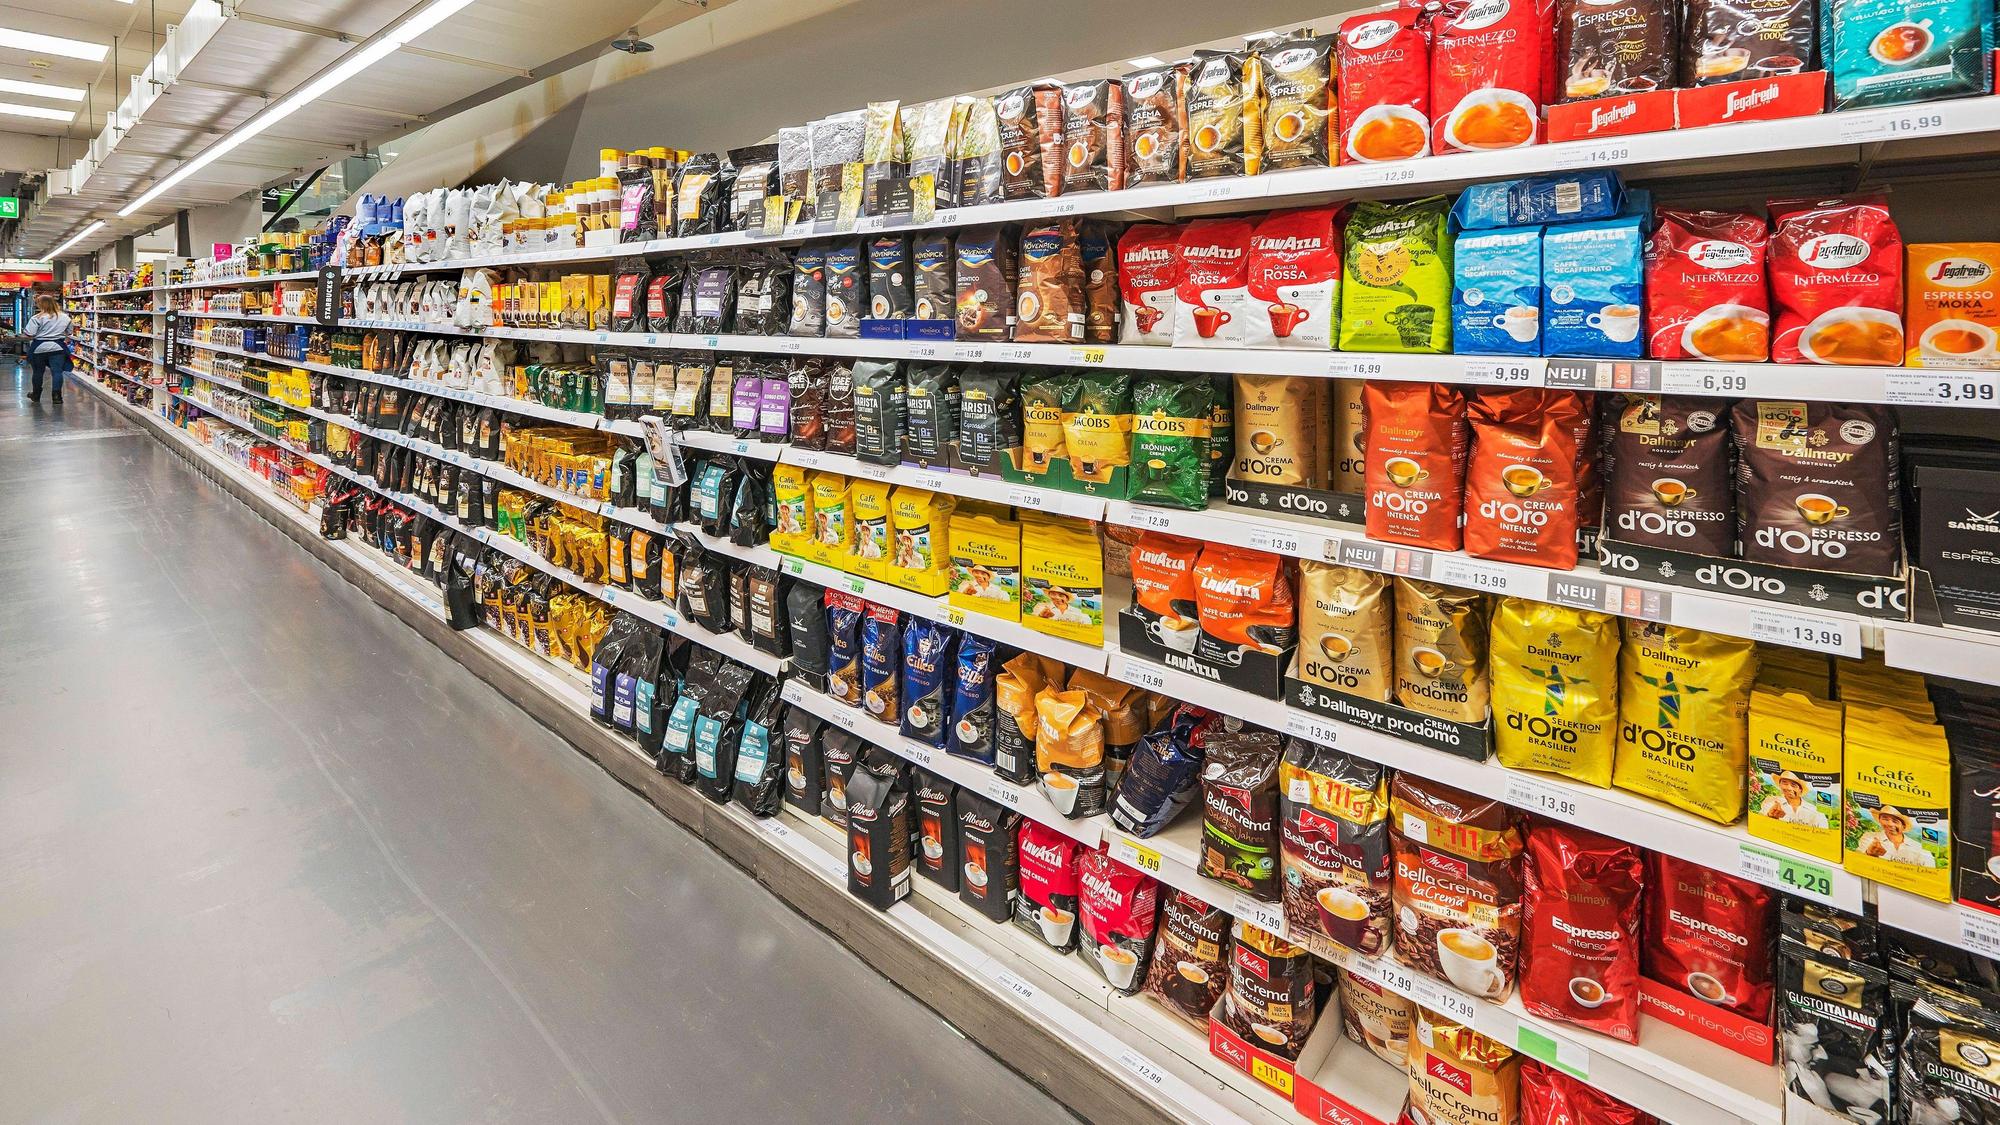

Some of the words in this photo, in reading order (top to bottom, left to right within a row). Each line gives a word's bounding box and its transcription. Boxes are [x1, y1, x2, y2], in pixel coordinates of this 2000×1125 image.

[1578, 8, 1636, 28] ESPRESSO
[1612, 15, 1646, 27] CASA
[1444, 28, 1517, 49] INTERMEZZO
[1342, 49, 1404, 67] INTERMEZZO
[1722, 84, 1779, 118] Segafredo
[1132, 109, 1161, 121] CREMA
[1588, 101, 1636, 133] Segafredo
[1067, 120, 1090, 130] CREMA
[1889, 115, 1942, 132] 16,99
[1590, 148, 1628, 161] 14,99
[1384, 170, 1414, 181] 12,99
[1208, 187, 1231, 197] 16,99
[1363, 219, 1416, 236] LAVAZZA
[1259, 236, 1321, 251] LAVAZZA
[1805, 239, 1865, 262] Segafredo
[1124, 248, 1169, 263] LAVAZZA
[1184, 246, 1242, 258] LAVAZZA
[1465, 264, 1486, 272] CAFFÈ
[1554, 260, 1577, 268] CAFFÈ
[1554, 265, 1612, 274] DECAFFEINATO
[1190, 274, 1229, 285] ROSSA
[1264, 268, 1307, 280] ROSSA
[1465, 268, 1517, 277] DECAFFEINATO
[1681, 271, 1759, 284] INTERMEZZO
[1794, 272, 1879, 287] INTERMEZZO
[325, 280, 333, 320] STARBUCKS
[1924, 291, 1993, 300] ESPRESSO
[1938, 299, 1983, 309] MOKA
[1014, 350, 1031, 359] 13,99
[1084, 353, 1104, 363] 9,99
[1353, 364, 1381, 374] 16,99
[1495, 368, 1529, 381] 9,99
[1547, 367, 1587, 381] NEU!
[832, 376, 851, 385] IDEE
[1704, 375, 1747, 391] 6,99
[1938, 383, 1994, 400] 3,99
[1246, 403, 1280, 413] Dallmayr
[1073, 416, 1110, 428] JACOBS
[1137, 419, 1185, 432] JACOBS
[1380, 424, 1424, 437] Dallmayr
[1141, 443, 1176, 452] KRÖNUNG
[1639, 434, 1696, 448] Dallmayr
[1265, 457, 1294, 465] CREMA
[1782, 448, 1853, 462] Dallmayr
[1240, 458, 1282, 476] d'Oro
[927, 480, 942, 488] 13,99
[1811, 476, 1854, 486] aromatisch
[859, 494, 875, 503] Café
[1023, 496, 1041, 506] 12,99
[1279, 493, 1328, 513] d'Oro
[1373, 491, 1428, 514] d'Oro
[1405, 490, 1442, 500] CREMA
[900, 502, 915, 511] Café
[1480, 500, 1548, 526] d'Oro
[1524, 500, 1563, 511] CREMA
[895, 509, 921, 519] Intención
[1148, 516, 1170, 528] 12,99
[1387, 512, 1420, 522] INTENSA
[1666, 509, 1725, 521] ESPRESSO
[1500, 523, 1539, 534] INTENSA
[1618, 509, 1696, 538] d'Oro
[1948, 521, 2000, 533] SANSIB
[1755, 526, 1847, 559] d'Oro
[1811, 528, 1881, 542] ESPRESSO
[957, 545, 1008, 561] Intención
[968, 540, 996, 552] Café
[1271, 539, 1297, 551] 13,99
[1139, 550, 1186, 571] LAVAZZA
[1345, 547, 1376, 562] NEU!
[1032, 565, 1089, 582] Intención
[1044, 560, 1076, 572] Café
[1473, 572, 1507, 589] 13,99
[1695, 564, 1786, 595] d'Oro
[1201, 576, 1260, 600] LAVAZZA
[1556, 582, 1597, 601] NEU!
[1316, 600, 1357, 617] Dallmayr
[949, 612, 964, 625] 9,99
[1407, 612, 1449, 629] Dallmayr
[1794, 626, 1842, 646] 13,99
[1527, 644, 1583, 664] Dallmayr
[1642, 646, 1701, 669] Dallmayr
[1165, 653, 1221, 681] LAVAZZA
[1306, 662, 1358, 688] d'Oro
[1338, 665, 1371, 676] CREMA
[1142, 673, 1163, 688] 13,99
[1432, 680, 1467, 691] CREMA
[1400, 677, 1468, 703] prodomo
[1320, 694, 1384, 725] Dallmayr
[1387, 716, 1460, 747] prodomo
[1424, 718, 1460, 735] CREMA
[1506, 713, 1578, 744] d'Oro
[1552, 717, 1601, 731] SELEKTION
[1309, 725, 1337, 743] 13,99
[1667, 730, 1724, 750] SELEKTION
[1774, 732, 1811, 751] Café
[1528, 736, 1577, 754] BRASILIEN
[1623, 723, 1696, 762] d'Oro
[1760, 738, 1825, 765] Intención
[1641, 750, 1694, 773] BRASILIEN
[1873, 765, 1915, 783] Café
[1857, 771, 1932, 799] Intención
[916, 787, 945, 801] Alberto
[1001, 790, 1019, 804] 13,99
[921, 806, 940, 817] ESPRESSO
[1206, 790, 1271, 832] BellaCrema
[1540, 795, 1575, 816] 13,99
[1907, 808, 1939, 817] Espresso
[960, 811, 990, 829] Alberto
[1022, 838, 1063, 870] LAVAZZA
[1283, 827, 1362, 869] BellaCrema
[1138, 857, 1160, 872] 9,99
[1304, 848, 1341, 869] Intenso
[1398, 862, 1494, 903] BellaCrema
[1783, 867, 1830, 896] 4,29
[1678, 881, 1738, 908] Dallmayr
[1163, 898, 1220, 942] BellaCrema
[1255, 910, 1280, 929] 12,99
[1552, 915, 1620, 940] Espresso
[1669, 909, 1749, 948] Espresso
[1567, 936, 1608, 951] intenso
[1685, 930, 1731, 952] intenso
[1381, 968, 1412, 992] 12,99
[1012, 982, 1033, 998] 13,99
[1442, 994, 1474, 1019] 12,99
[1688, 1008, 1745, 1042] intenso
[1137, 1064, 1162, 1084] 12,99
[1430, 1062, 1470, 1088] Melitta
[1410, 1064, 1499, 1123] BellaCrema
